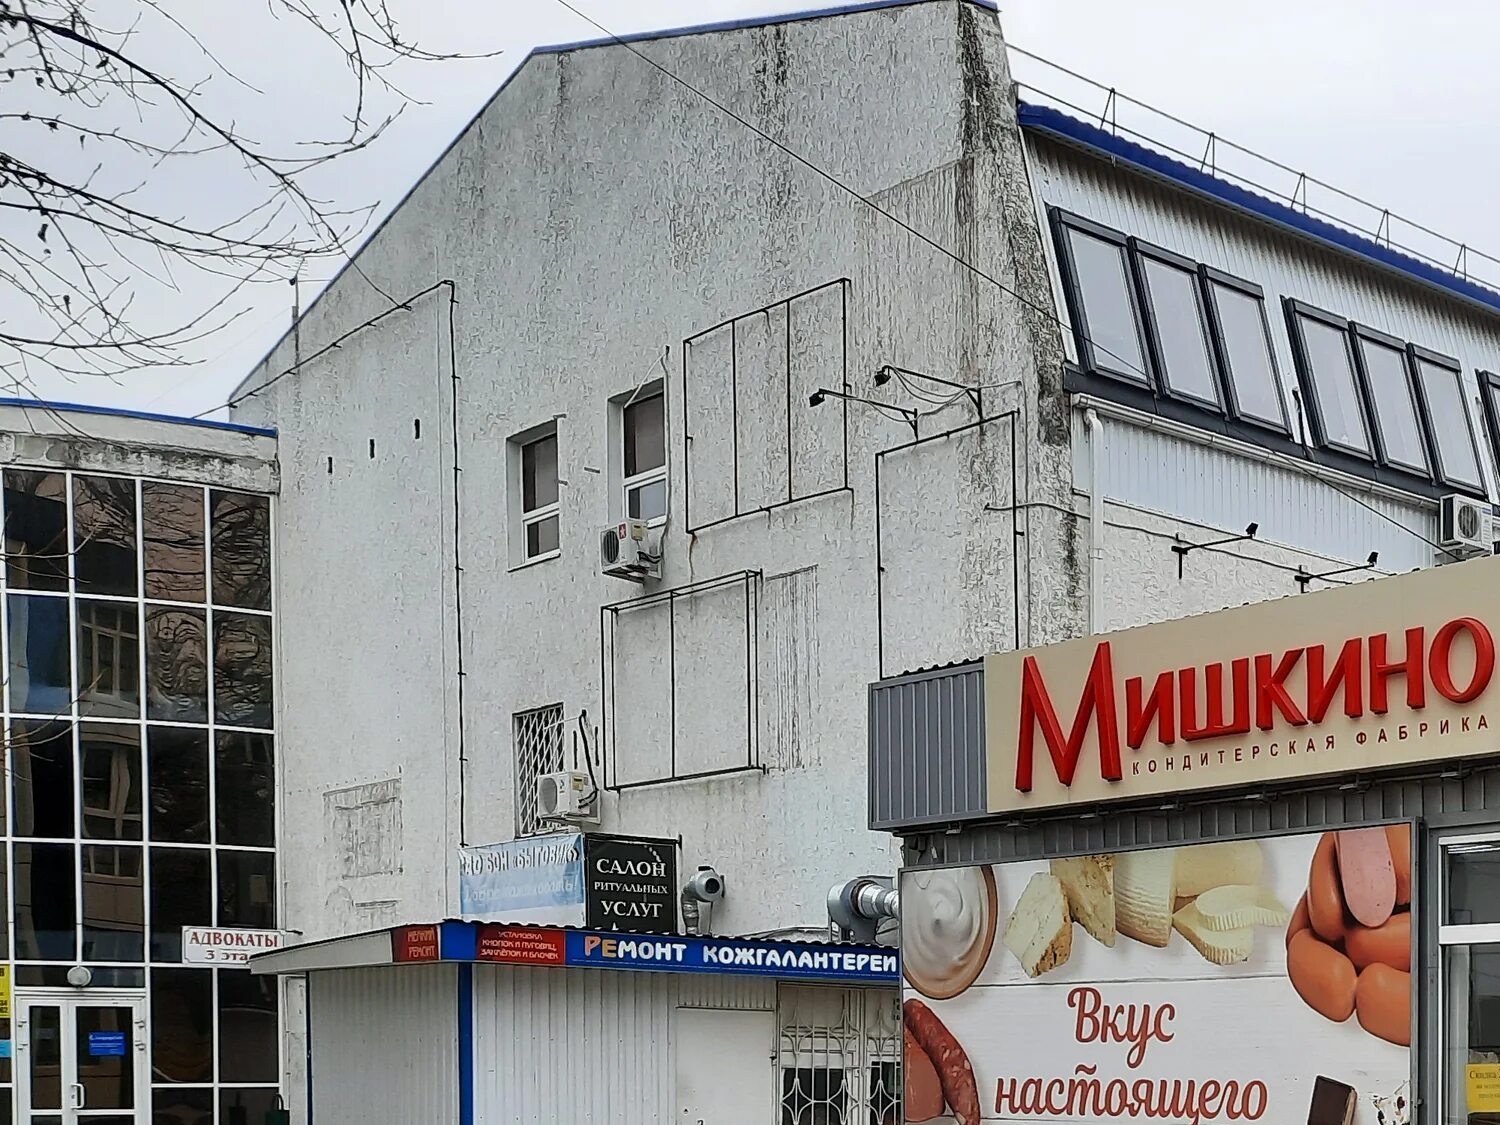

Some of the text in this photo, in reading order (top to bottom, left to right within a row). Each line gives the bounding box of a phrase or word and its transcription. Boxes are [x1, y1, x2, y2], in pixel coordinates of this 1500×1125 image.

[1132, 714, 1489, 775] КОНДИТЕРСКАЯ ФАБРИКА
[596, 858, 667, 877] САЛОН
[594, 881, 669, 894] РИТУАЛЬНЫХ
[601, 900, 663, 918] УСЛУГ
[189, 931, 278, 948] АДВОКАТЫ
[204, 950, 250, 961] 3 эта
[584, 935, 897, 973] РЕМОНТ КОЖГАЛАНТЕРЕИ
[1067, 986, 1176, 1068] Вкус
